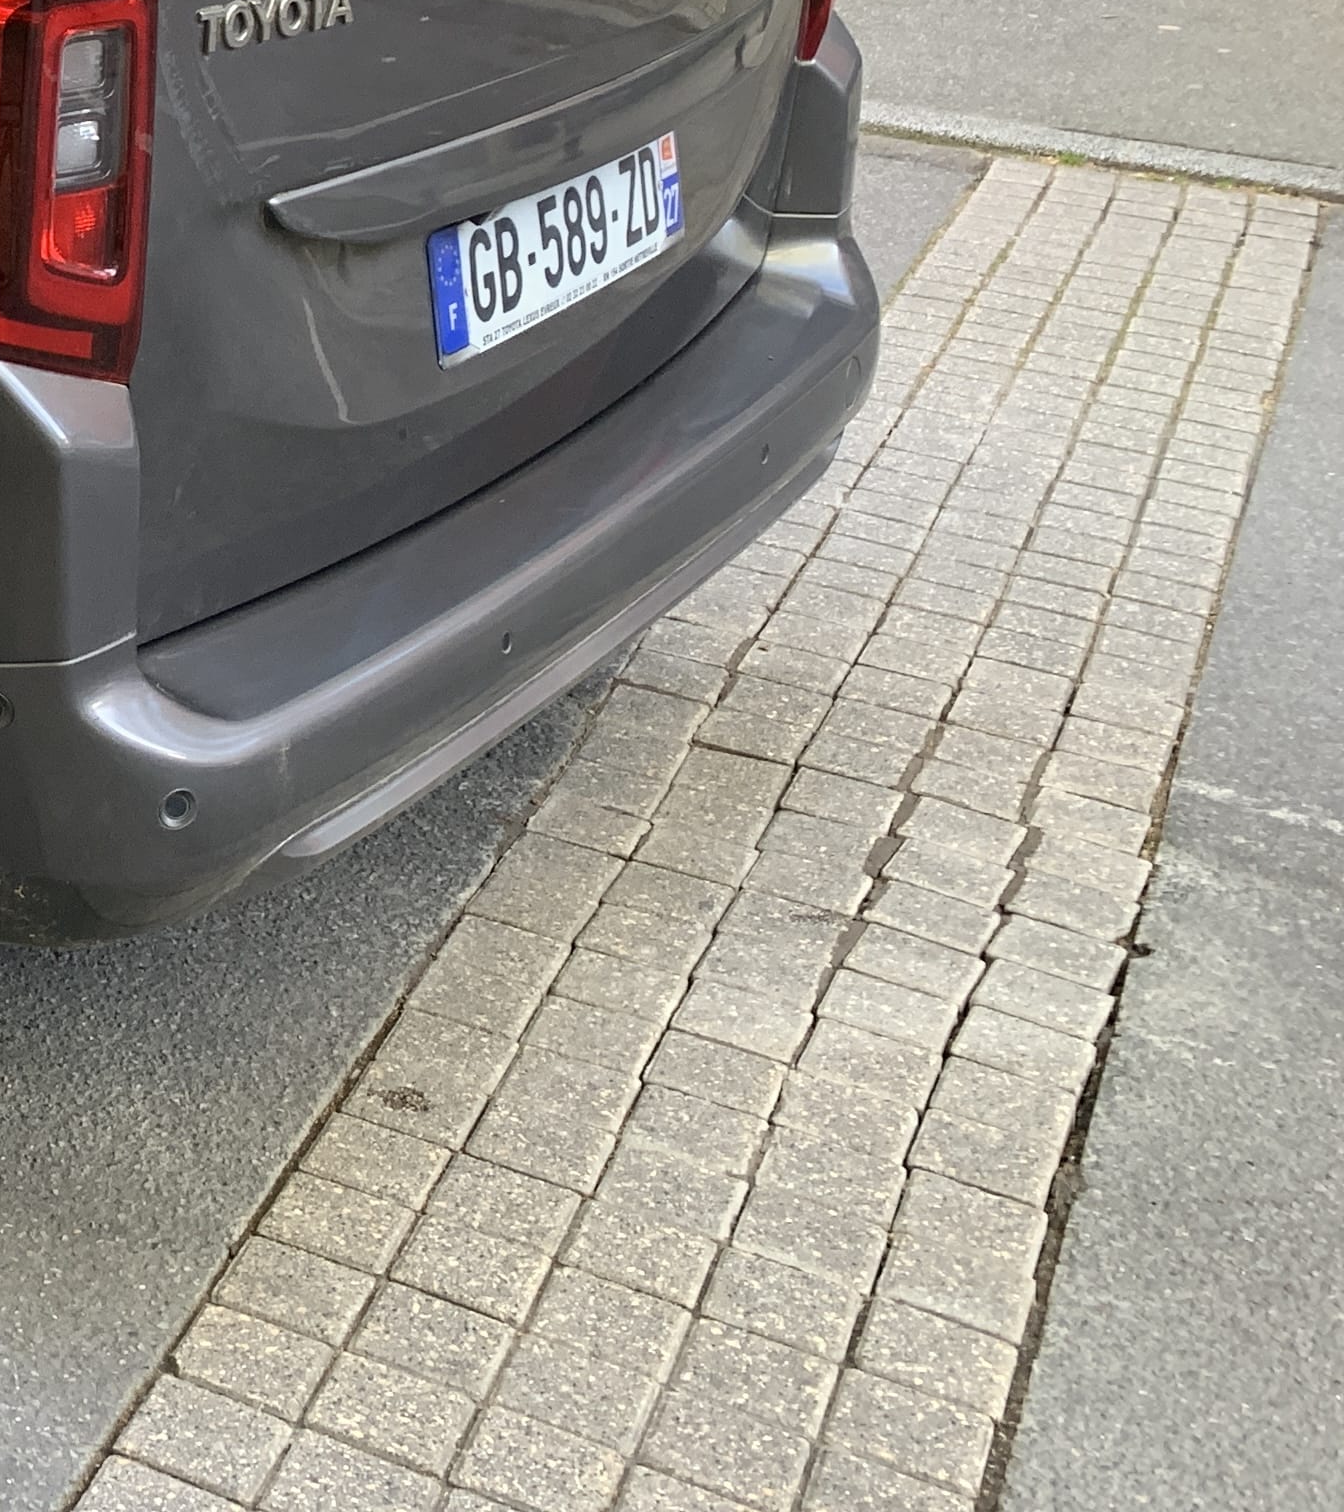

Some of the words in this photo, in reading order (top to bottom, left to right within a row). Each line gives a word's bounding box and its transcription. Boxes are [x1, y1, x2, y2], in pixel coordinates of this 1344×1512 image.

[664, 182, 679, 228] 27
[468, 146, 660, 323] GB-589-ZD
[448, 302, 458, 331] F
[501, 319, 522, 335] TOYOTA
